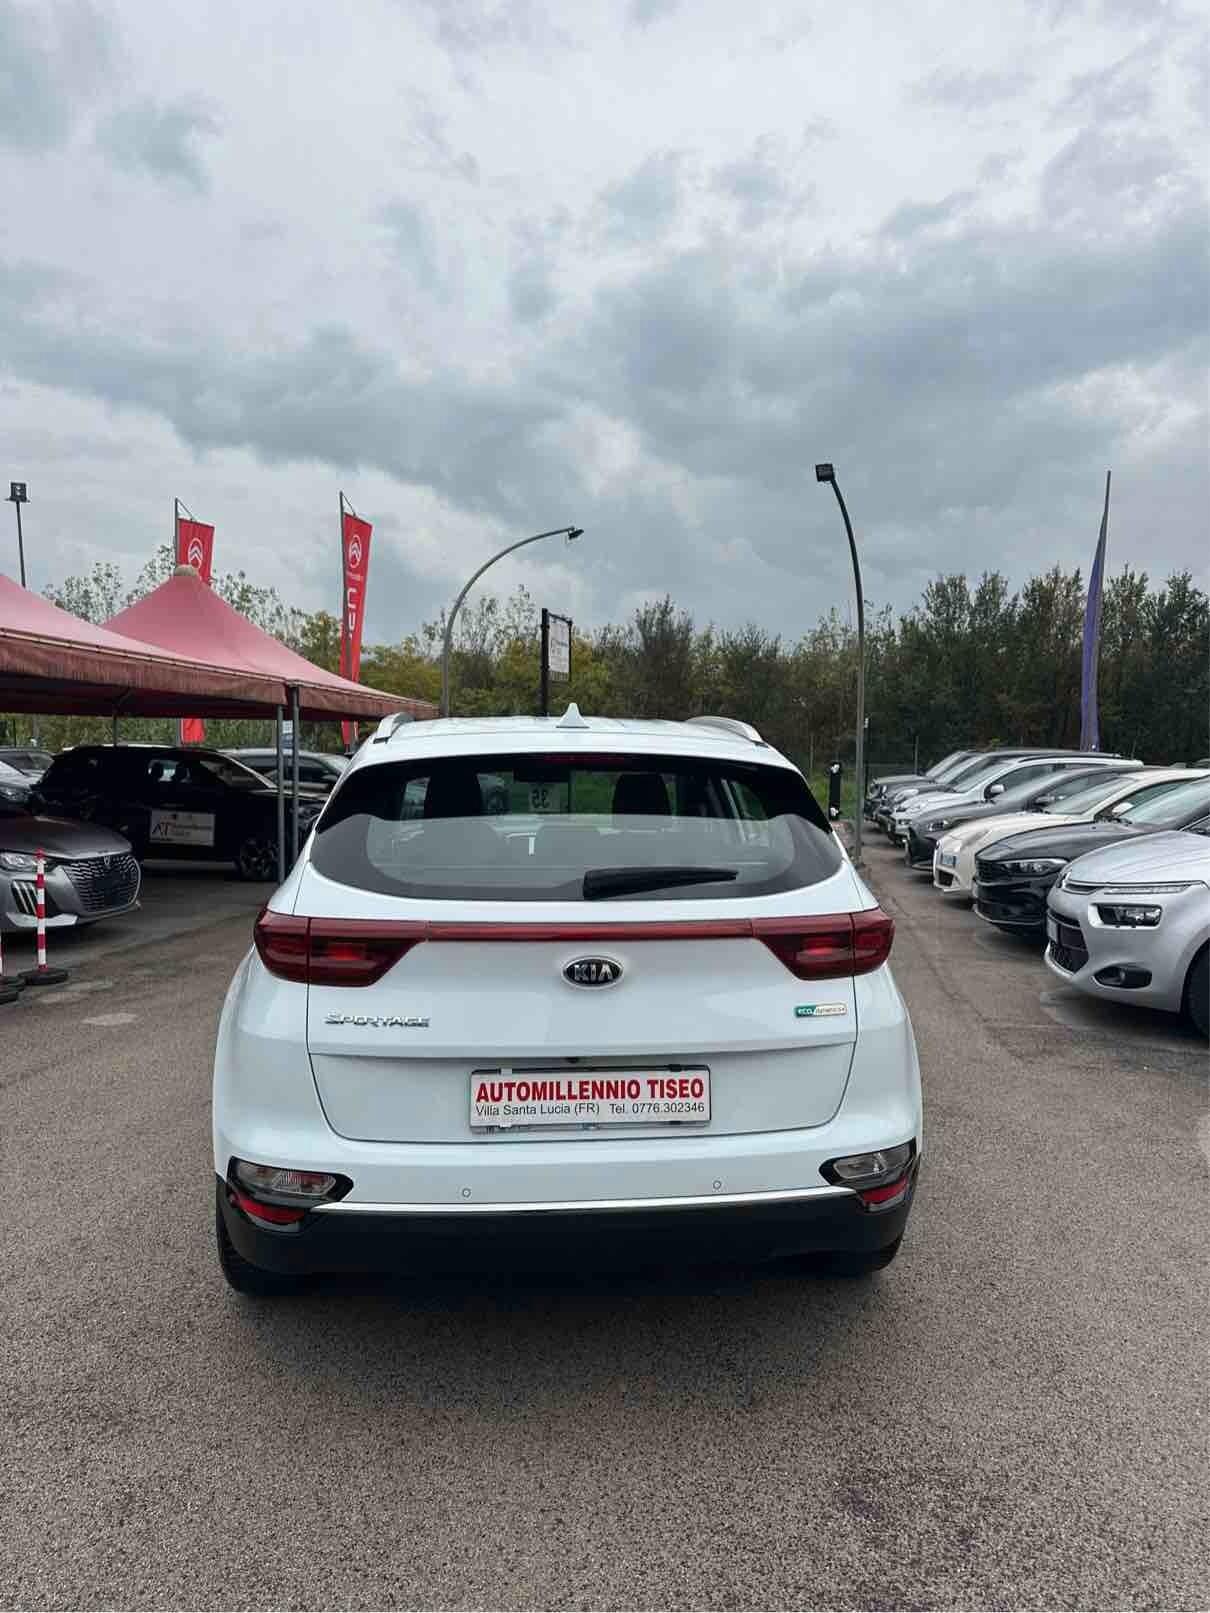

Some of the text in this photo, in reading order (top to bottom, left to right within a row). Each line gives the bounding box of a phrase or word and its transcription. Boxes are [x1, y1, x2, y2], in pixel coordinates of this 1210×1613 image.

[574, 963, 614, 981] KIA
[475, 1078, 704, 1103] AUTOMILLENNIO TISEO
[475, 1103, 500, 1116] Villa
[503, 1103, 537, 1116] Santa
[540, 1102, 571, 1115] Lucia
[574, 1102, 600, 1116] (FR)
[632, 1101, 705, 1114] 0776.302346
